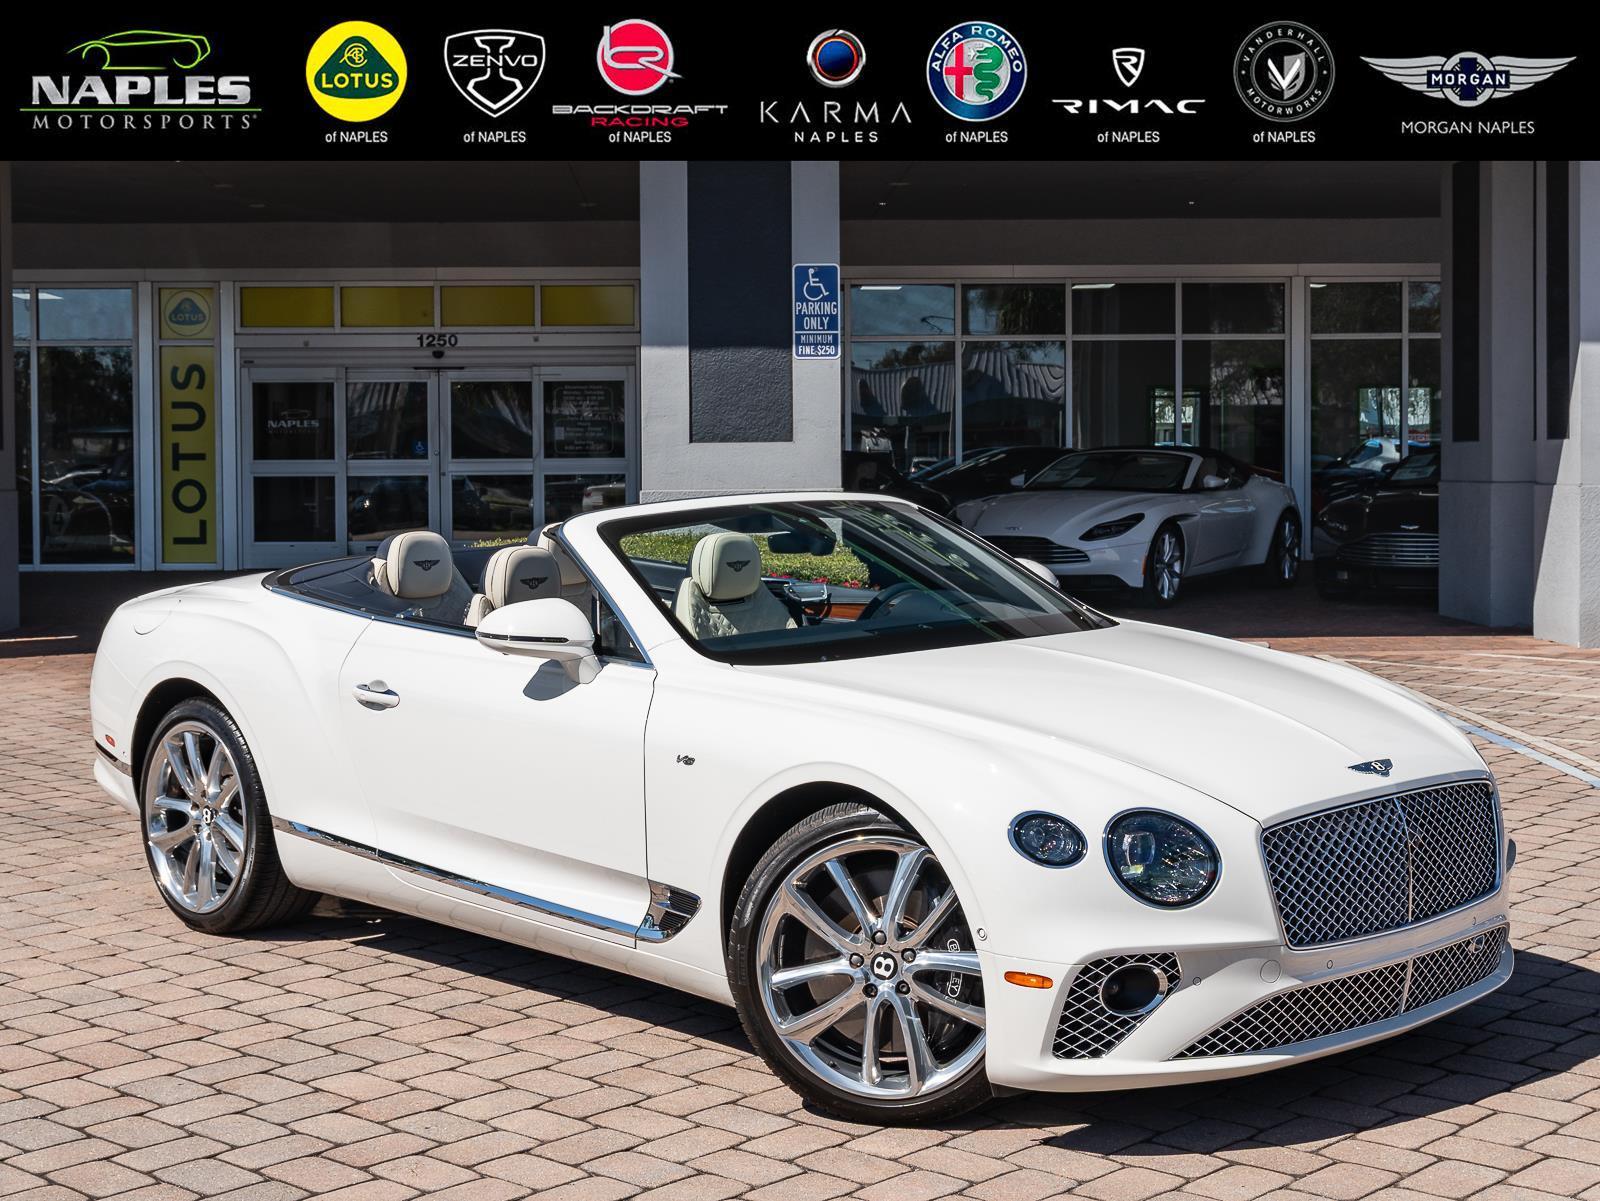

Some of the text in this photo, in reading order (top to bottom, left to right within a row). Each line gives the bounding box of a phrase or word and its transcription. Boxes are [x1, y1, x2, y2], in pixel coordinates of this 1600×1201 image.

[795, 301, 838, 315] PARKING
[171, 313, 205, 321] LOTUS
[804, 317, 829, 330] ONLY
[417, 334, 458, 347] 1250
[800, 334, 833, 344] MINIMUM
[798, 345, 836, 356] FINE $250
[267, 419, 320, 428] NAPLES
[170, 362, 208, 545] LOTUS
